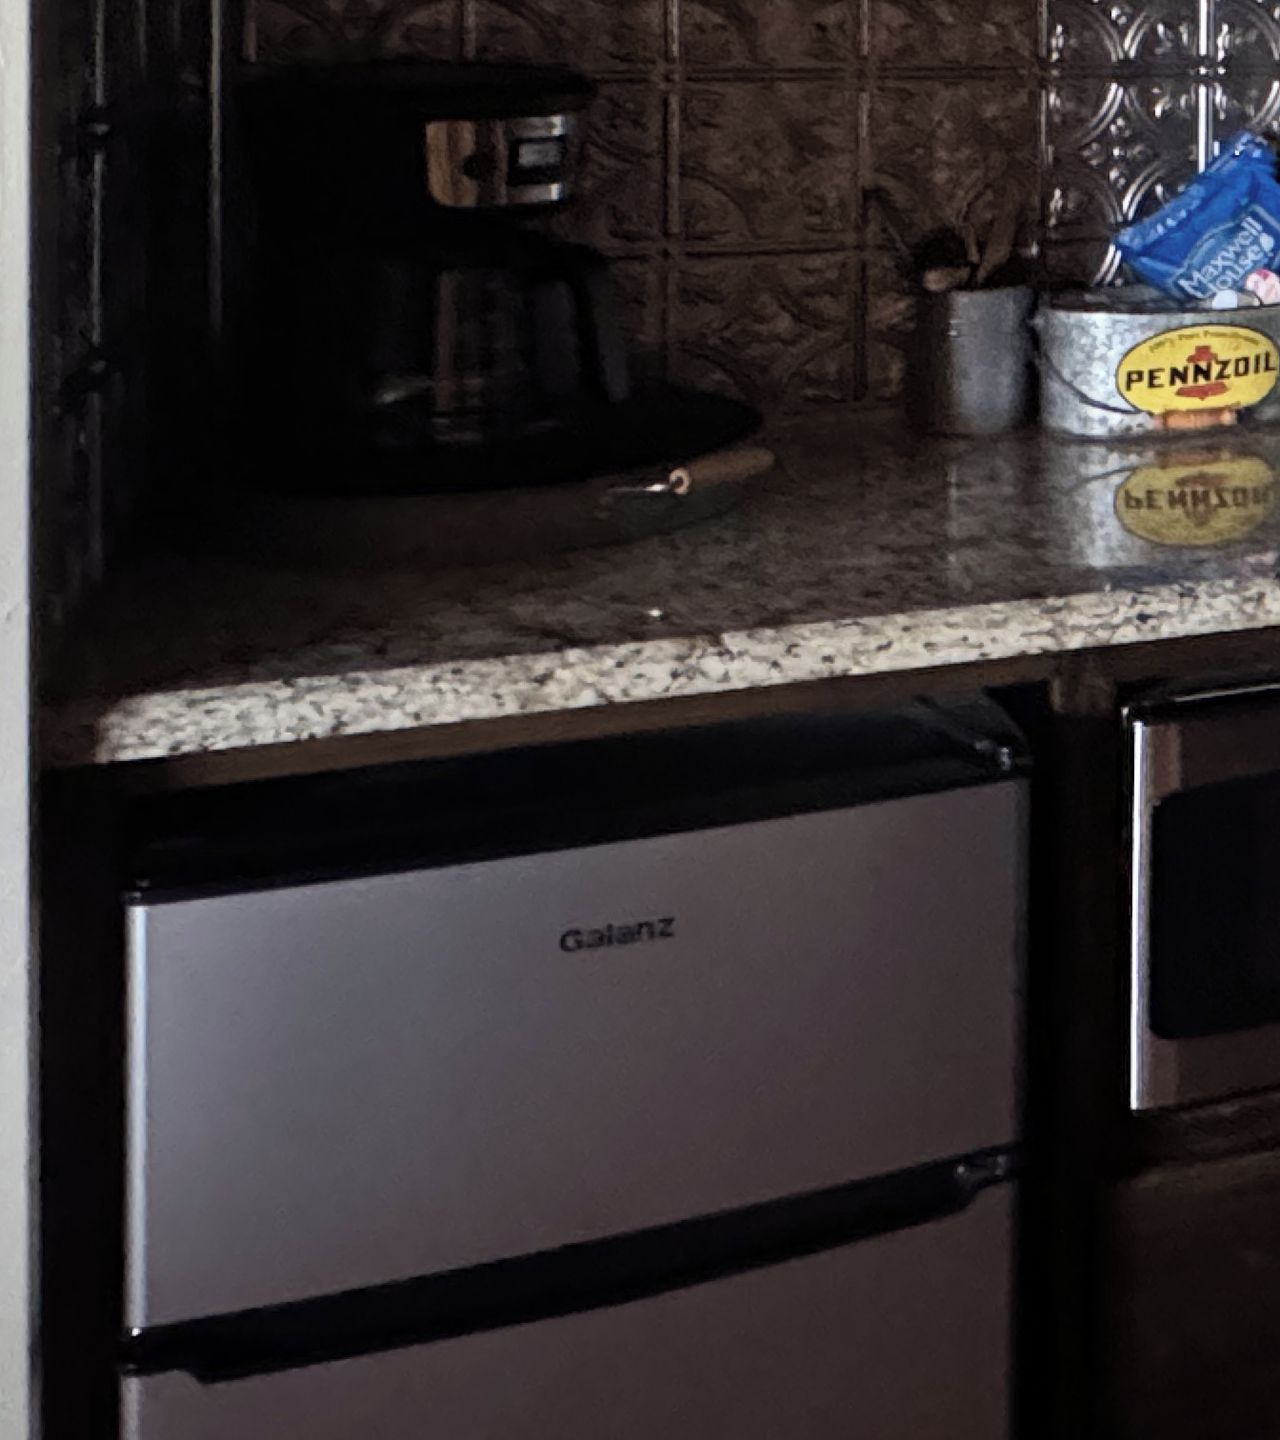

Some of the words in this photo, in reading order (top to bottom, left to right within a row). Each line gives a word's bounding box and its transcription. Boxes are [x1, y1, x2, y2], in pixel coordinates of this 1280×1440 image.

[1178, 216, 1262, 298] Maxwell
[1125, 350, 1277, 392] PENNZOIL
[559, 917, 676, 953] Galanz
